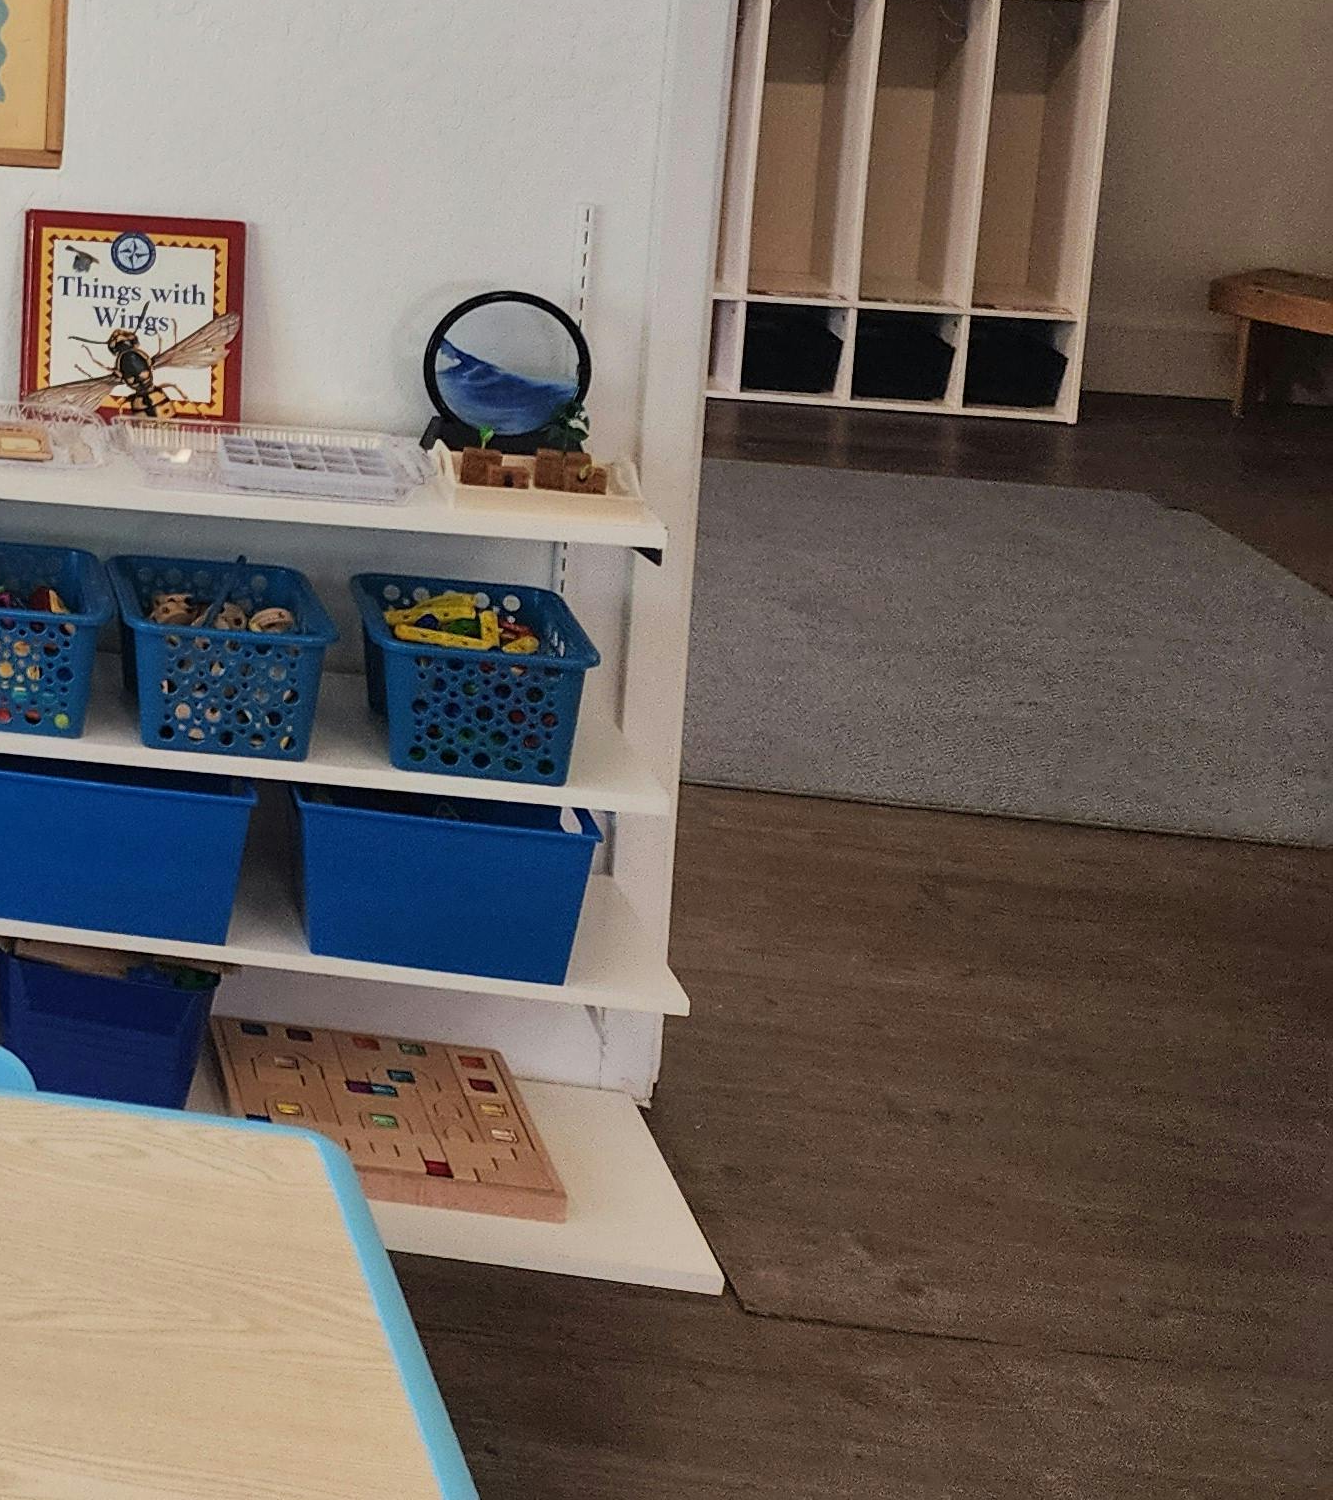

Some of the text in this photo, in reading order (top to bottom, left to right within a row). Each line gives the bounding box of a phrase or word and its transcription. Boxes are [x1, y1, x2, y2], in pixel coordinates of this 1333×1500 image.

[57, 275, 206, 306] Things with
[93, 305, 169, 335] Wings
